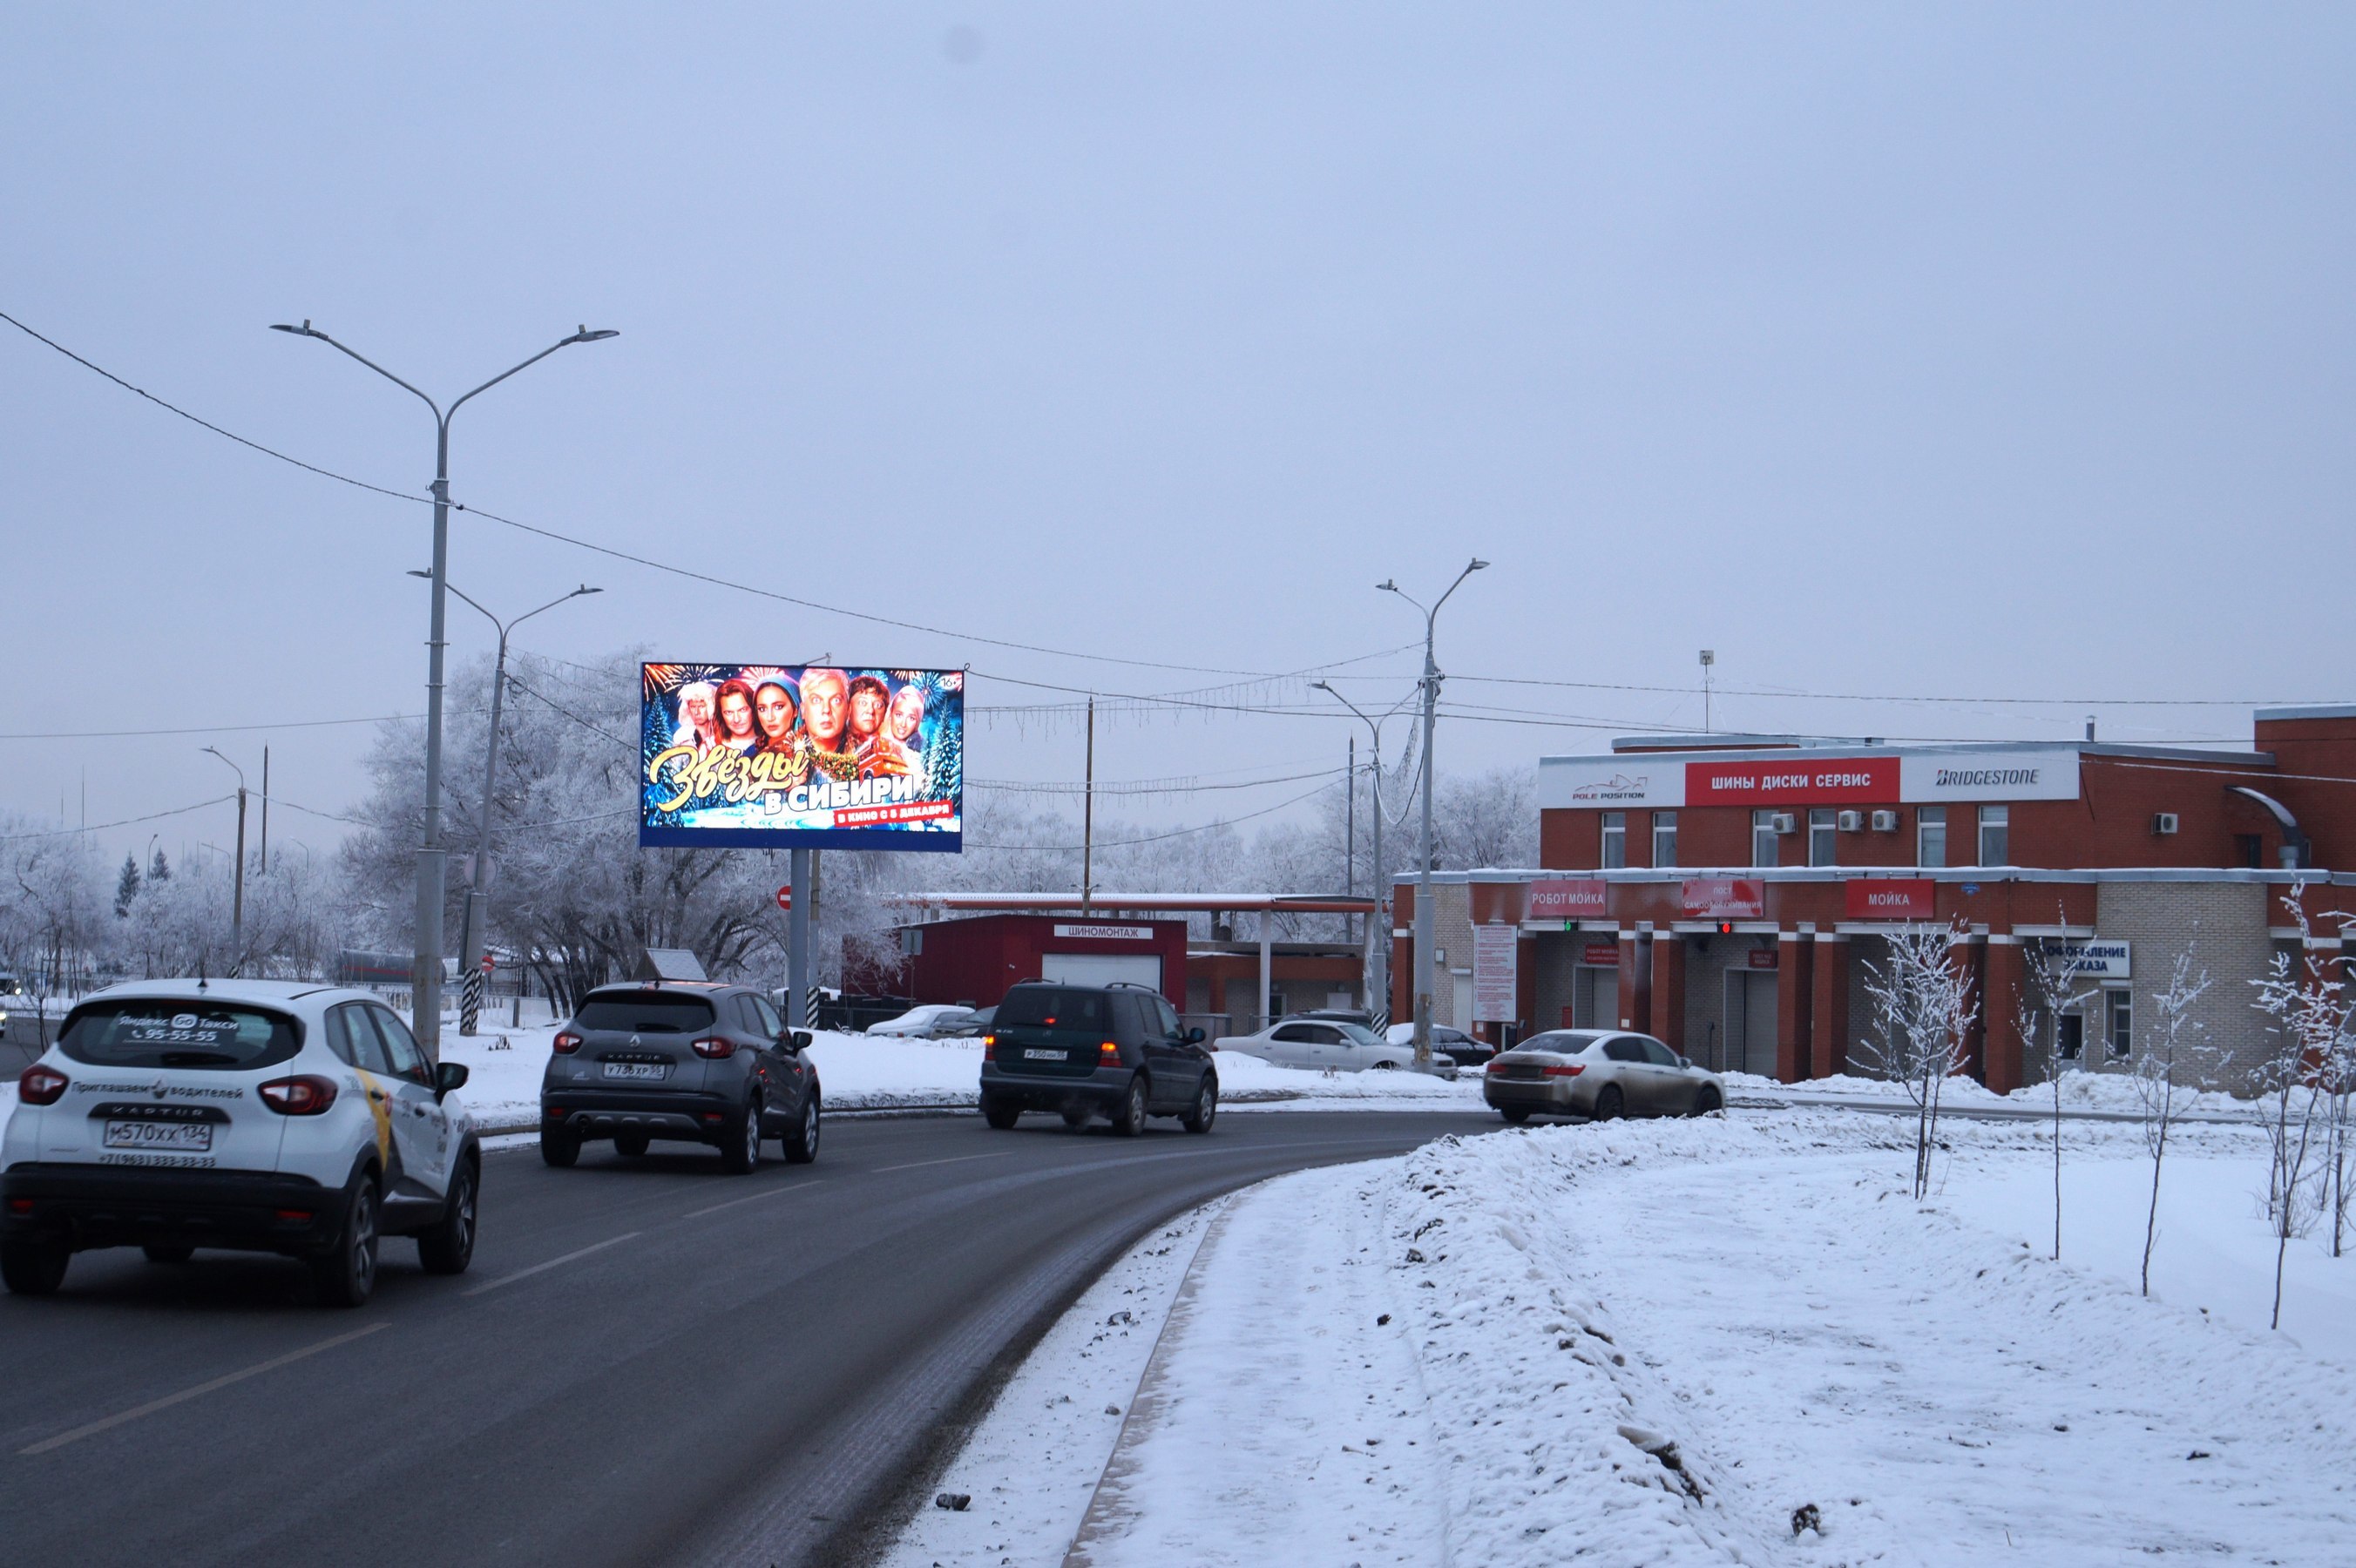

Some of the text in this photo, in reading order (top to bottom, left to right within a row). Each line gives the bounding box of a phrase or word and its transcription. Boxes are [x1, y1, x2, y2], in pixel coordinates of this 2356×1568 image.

[649, 744, 810, 812] Звёзды
[1711, 774, 1871, 790] ШИНЫ ДИСКИ СЕРВИС
[788, 774, 914, 812] СИБИРИ
[848, 810, 877, 822] КИНО
[899, 803, 950, 819] ДЕКАБРЯ
[1532, 892, 1604, 904] РОБОТ МОЙКА
[1868, 891, 1910, 905] МОЙКА
[1068, 927, 1139, 937] ШИНОМОНТАЖ
[118, 1016, 169, 1026] Яндекс
[199, 1018, 239, 1030] Такси
[145, 1029, 217, 1041] 95-55-55
